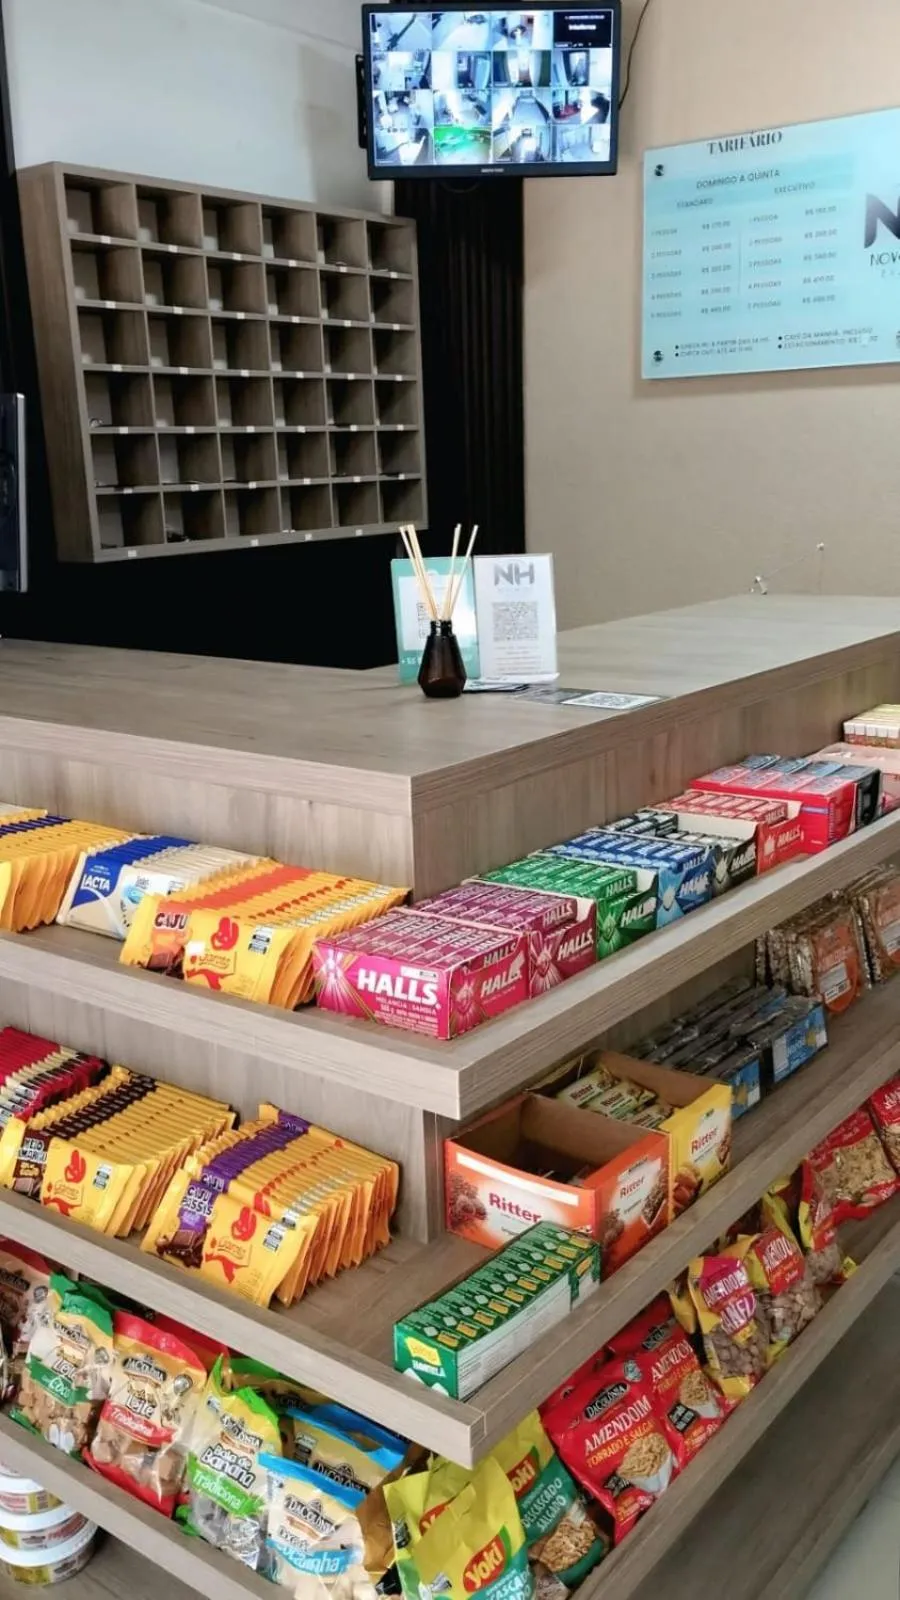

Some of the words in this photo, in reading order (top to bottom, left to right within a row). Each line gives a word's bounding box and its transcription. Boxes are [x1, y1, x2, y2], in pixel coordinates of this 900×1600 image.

[696, 175, 737, 189] DOMINGO
[747, 169, 780, 181] QUINTA
[774, 181, 815, 194] EXECUTIVO
[870, 251, 900, 266] NOV
[494, 563, 535, 586] NH
[82, 874, 110, 891] LACTA
[605, 875, 633, 899] HALLS
[154, 911, 188, 930] CAJU
[543, 902, 574, 928] HALLS
[557, 928, 595, 961] HALLS
[357, 968, 438, 1005] HALLS
[691, 1126, 717, 1154] Ritter
[187, 1186, 212, 1203] CAJU
[201, 1173, 225, 1190] CAJU
[619, 1175, 645, 1198] Ritter
[489, 1193, 541, 1223] Ritter
[584, 1394, 652, 1457] AMENDOIM
[201, 1446, 256, 1489] Banana
[586, 1440, 624, 1469] TORRADO
[511, 1460, 535, 1492] oki
[522, 1477, 563, 1529] DESCASCADO
[537, 1495, 566, 1533] SALGADO
